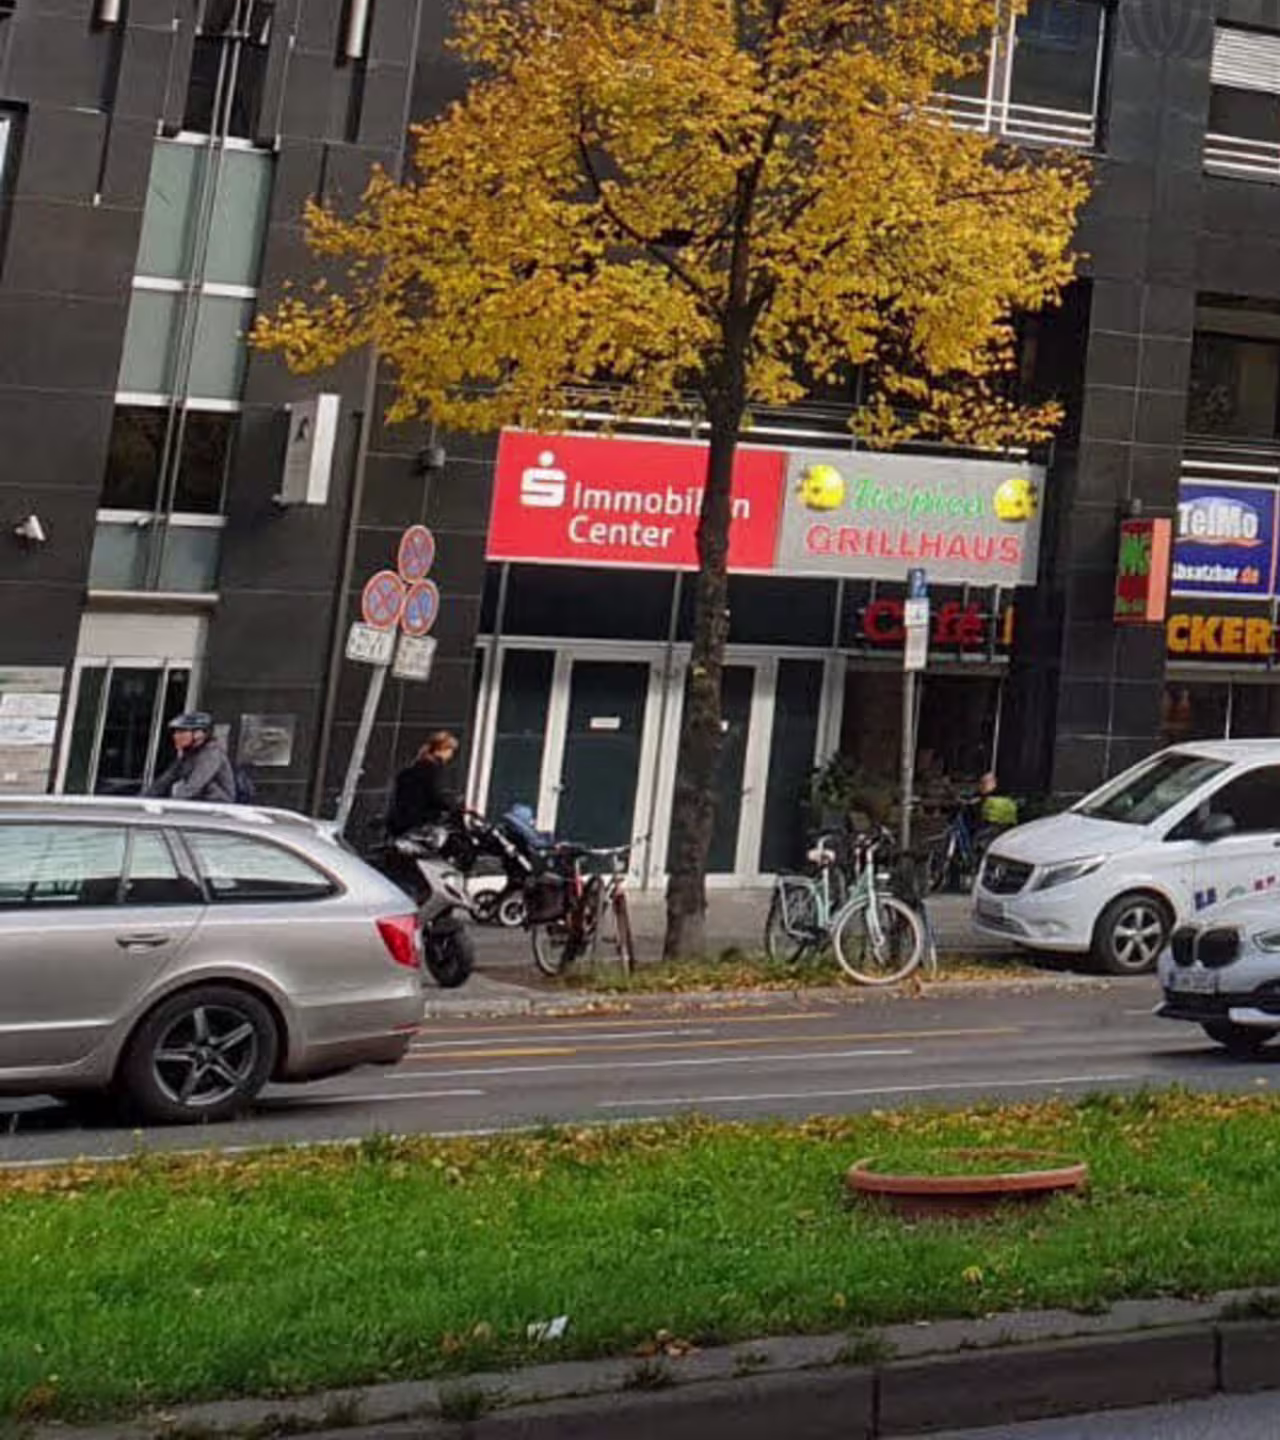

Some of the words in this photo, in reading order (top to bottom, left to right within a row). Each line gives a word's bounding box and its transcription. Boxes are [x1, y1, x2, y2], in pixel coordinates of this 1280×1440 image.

[573, 480, 750, 520] Immobiln
[568, 514, 673, 548] Center
[1177, 503, 1259, 540] TelMo
[806, 524, 1023, 564] GRILLHAUS
[863, 597, 985, 647] Cfé
[1167, 614, 1275, 655] CKER
